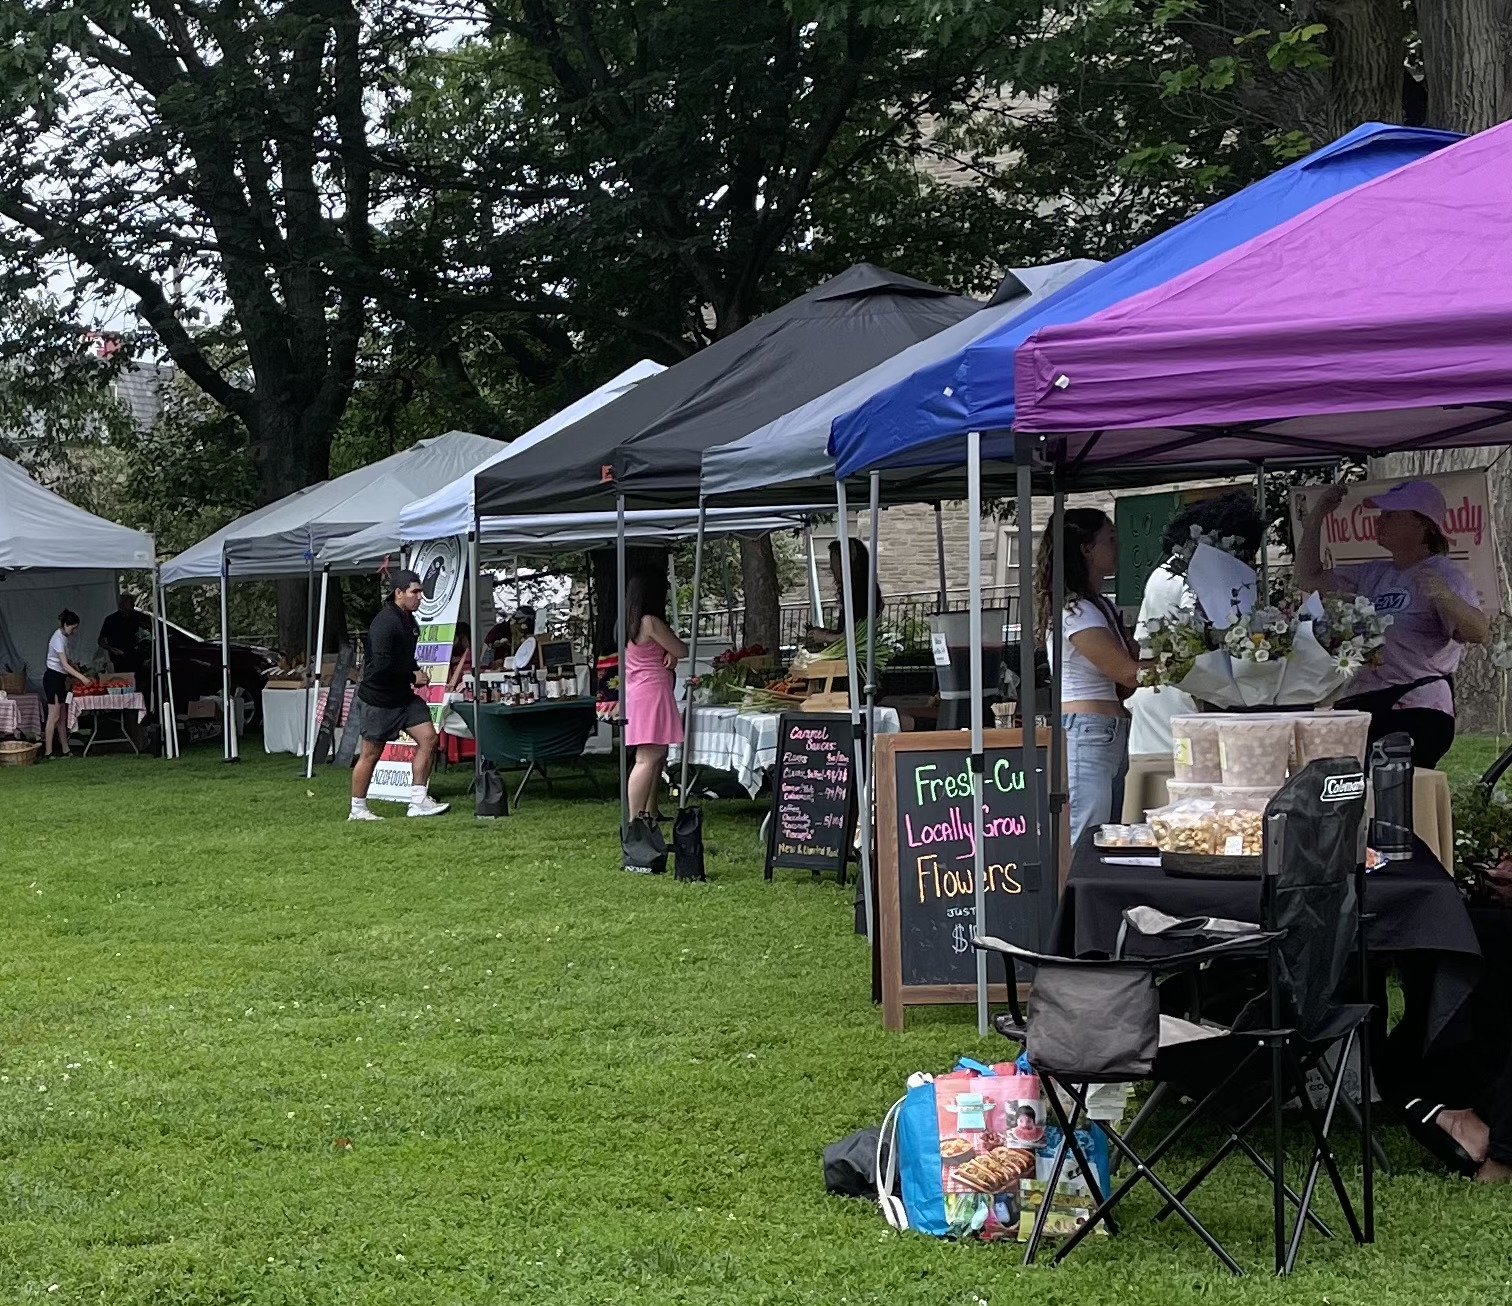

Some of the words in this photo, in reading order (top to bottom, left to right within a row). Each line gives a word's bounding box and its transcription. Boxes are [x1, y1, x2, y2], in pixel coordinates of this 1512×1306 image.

[1443, 496, 1486, 546] ady
[915, 756, 1043, 806] Fresh-Cu
[981, 804, 1042, 838] Grow
